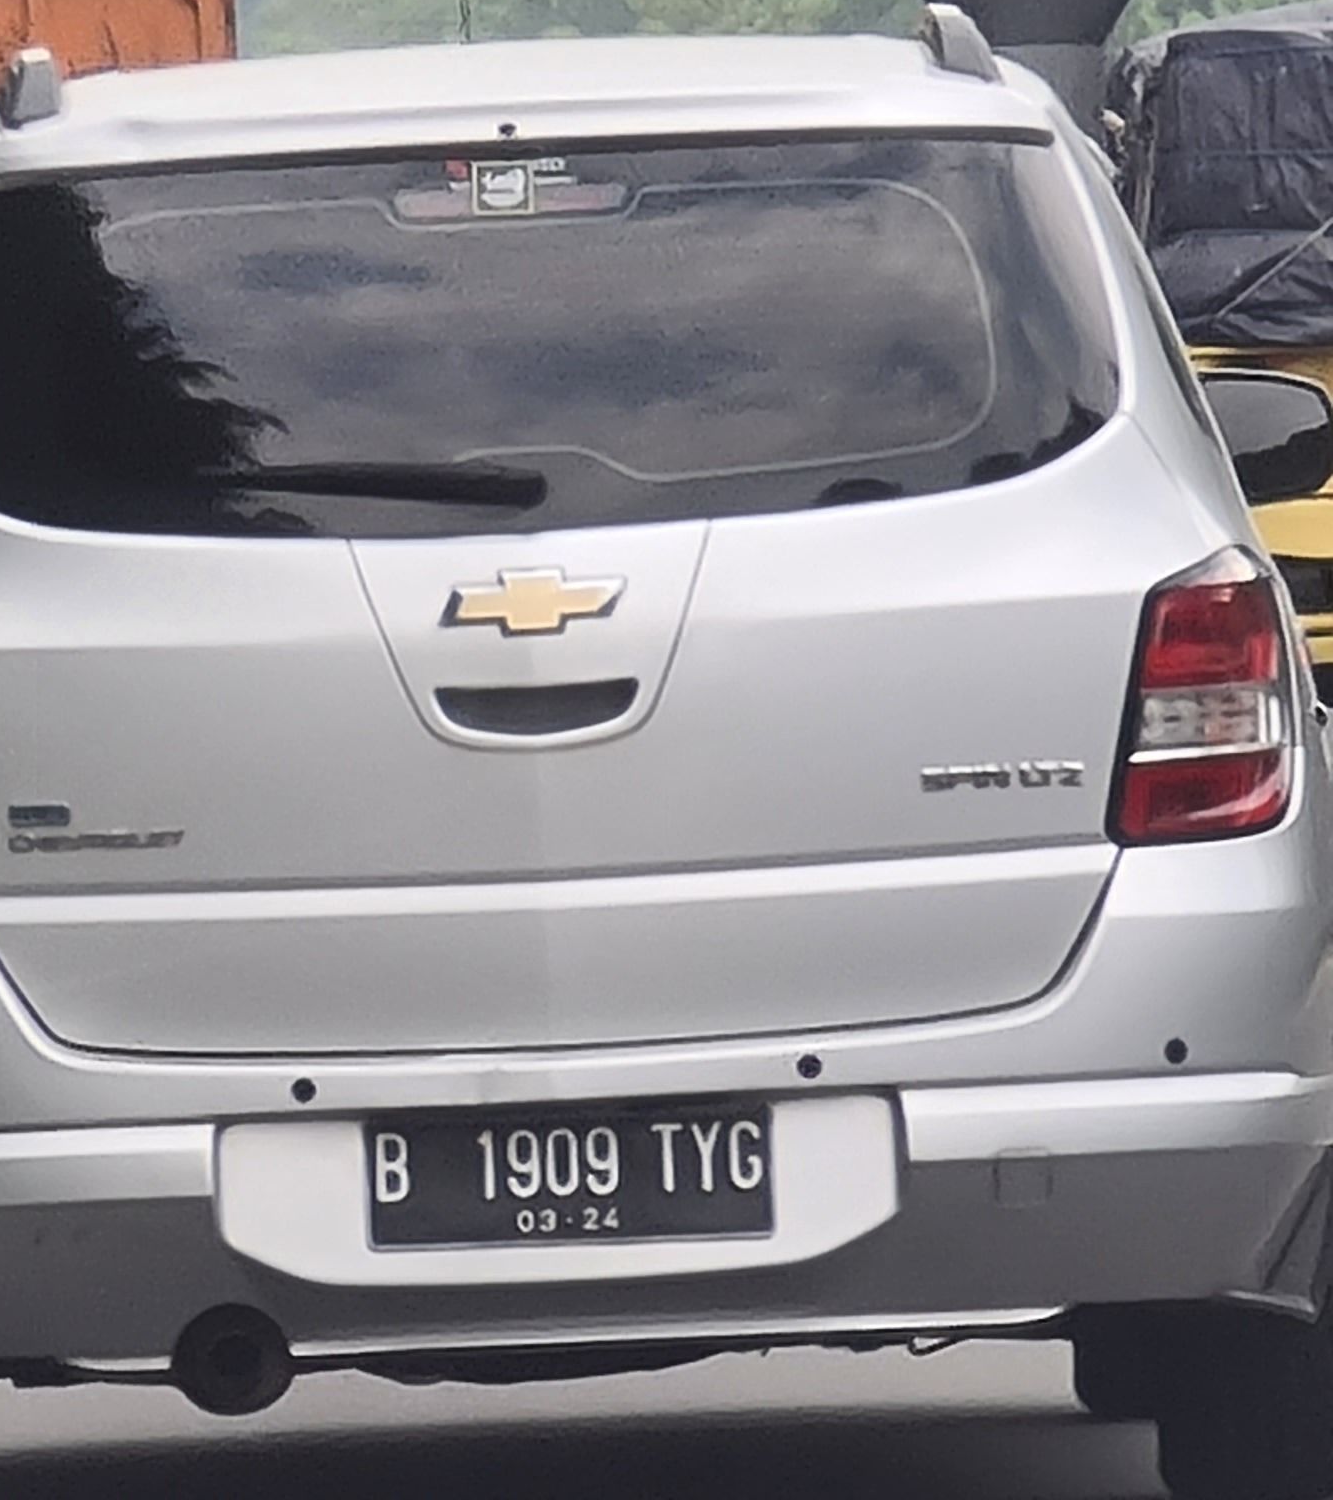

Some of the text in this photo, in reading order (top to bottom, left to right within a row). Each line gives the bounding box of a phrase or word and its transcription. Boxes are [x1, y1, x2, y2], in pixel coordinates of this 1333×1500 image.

[374, 1119, 764, 1203] B 1909 TYG
